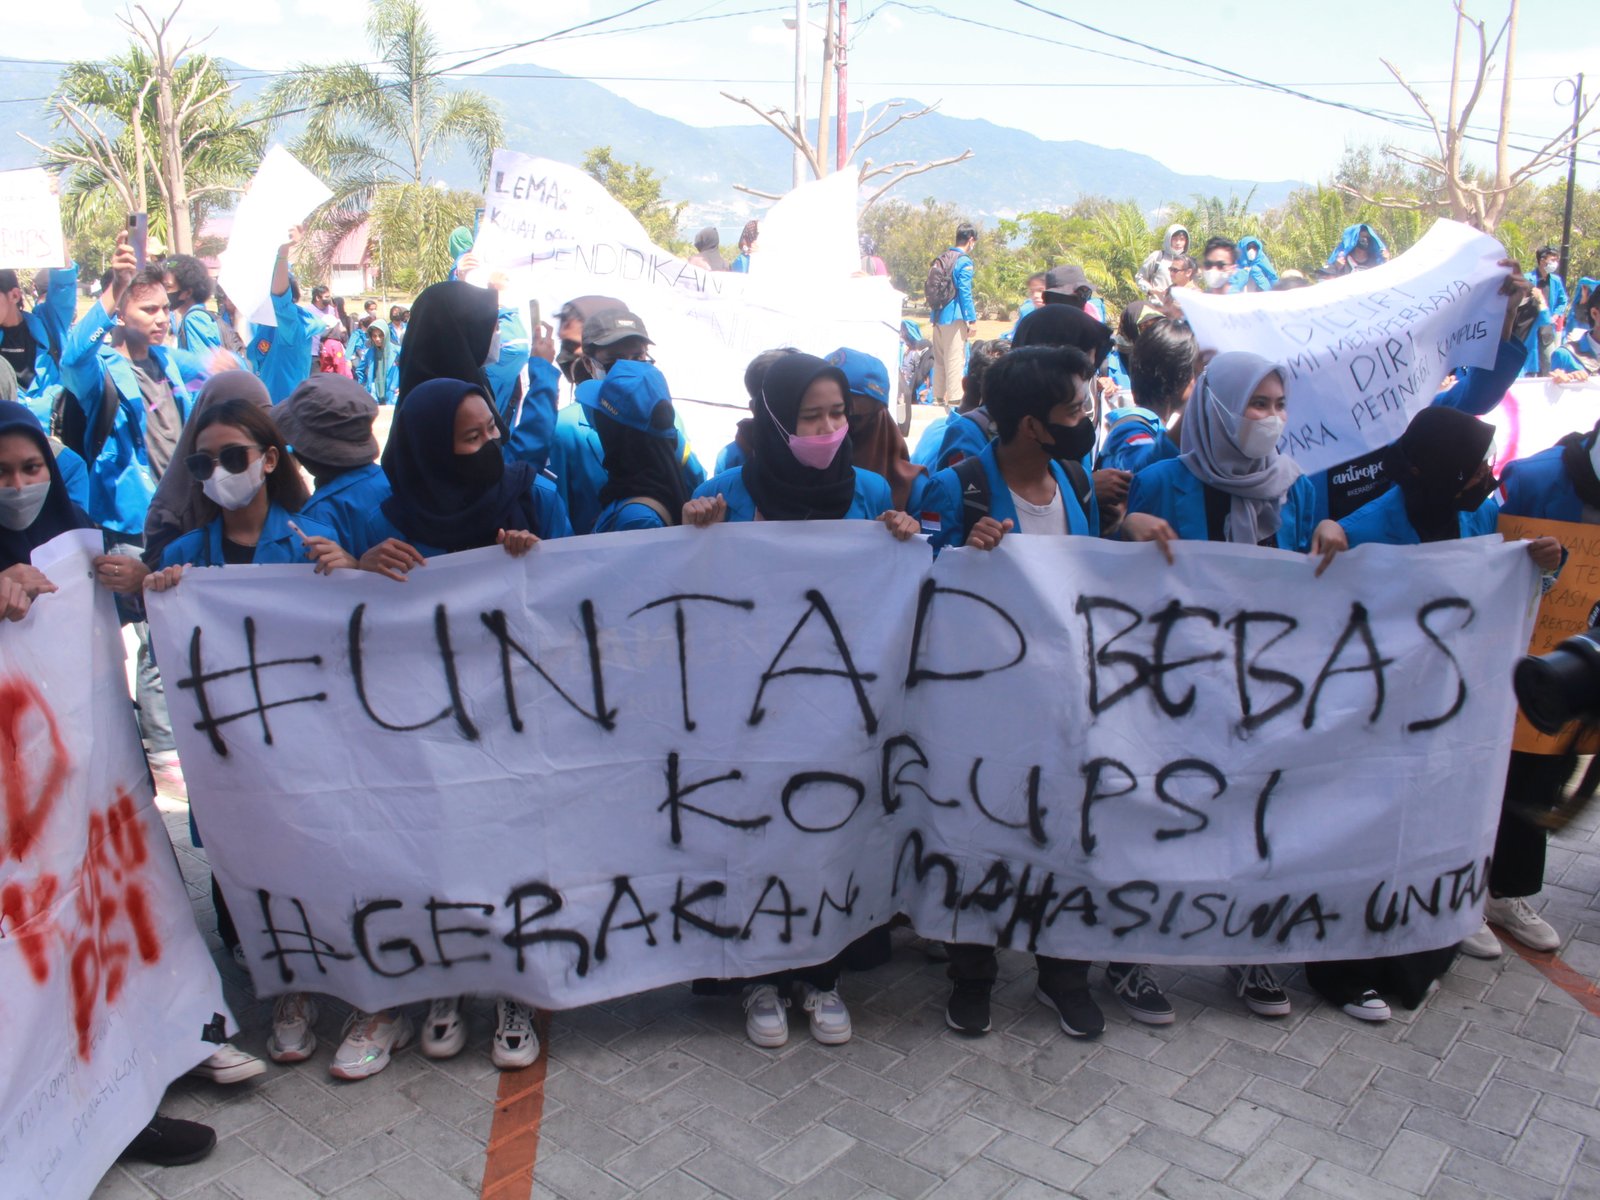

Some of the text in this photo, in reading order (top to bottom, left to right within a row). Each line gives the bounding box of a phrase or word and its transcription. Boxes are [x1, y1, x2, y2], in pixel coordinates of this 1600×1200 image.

[1280, 286, 1416, 346] DICURI
[1330, 279, 1471, 361] MEMPERKAYA
[1349, 330, 1415, 393] DIRI
[1275, 421, 1338, 457] PARA
[1437, 320, 1488, 360] KAMPUS
[1074, 596, 1476, 739] BEBAS
[656, 733, 1282, 861] KORUPSI
[891, 829, 1341, 952] MAHASISWA
